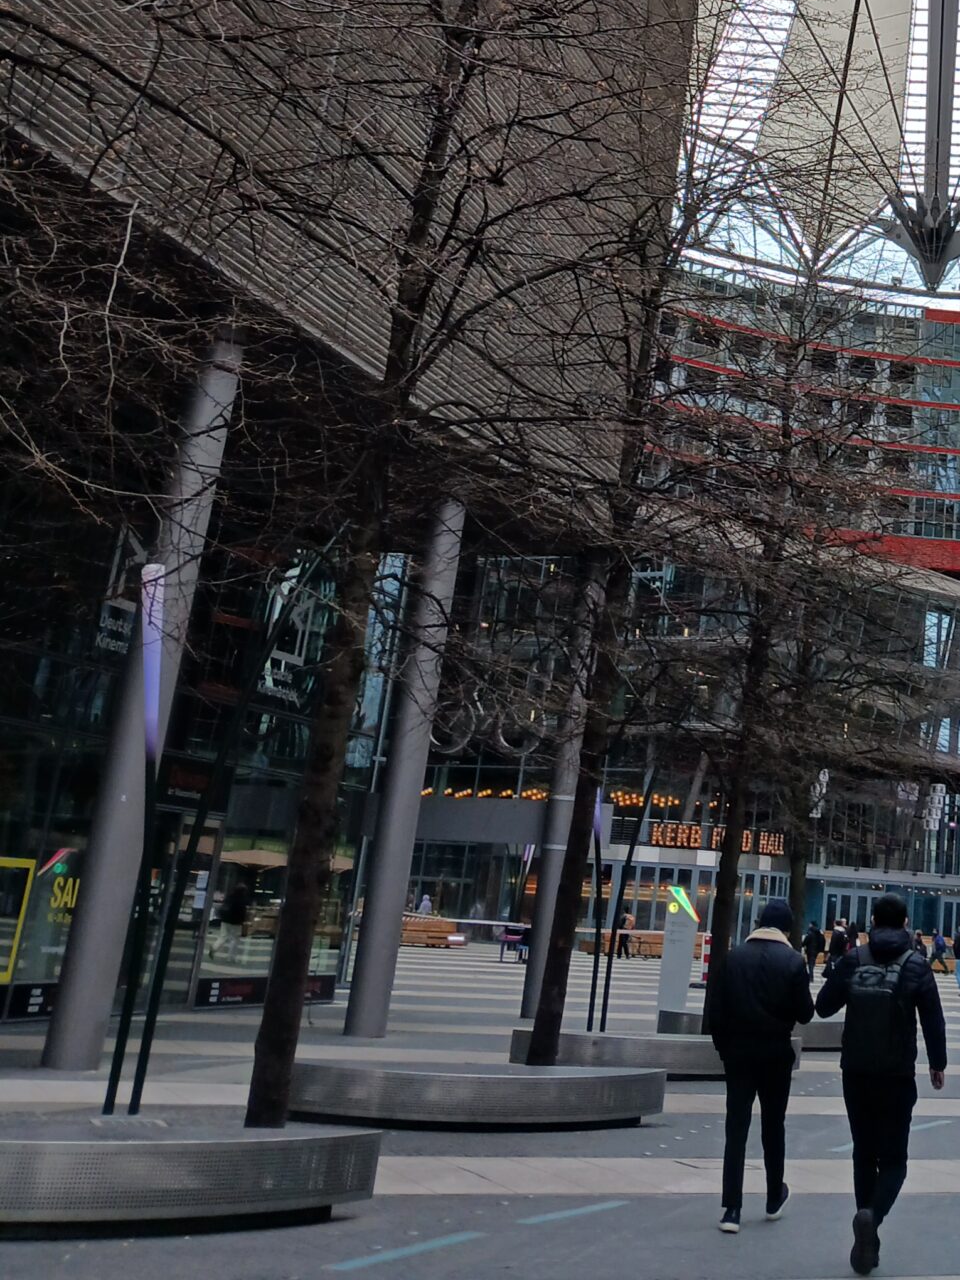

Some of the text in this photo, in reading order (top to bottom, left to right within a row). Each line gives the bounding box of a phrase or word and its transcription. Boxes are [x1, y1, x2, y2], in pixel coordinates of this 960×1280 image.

[651, 823, 785, 854] KERB FD HALL
[50, 876, 81, 908] SAL
